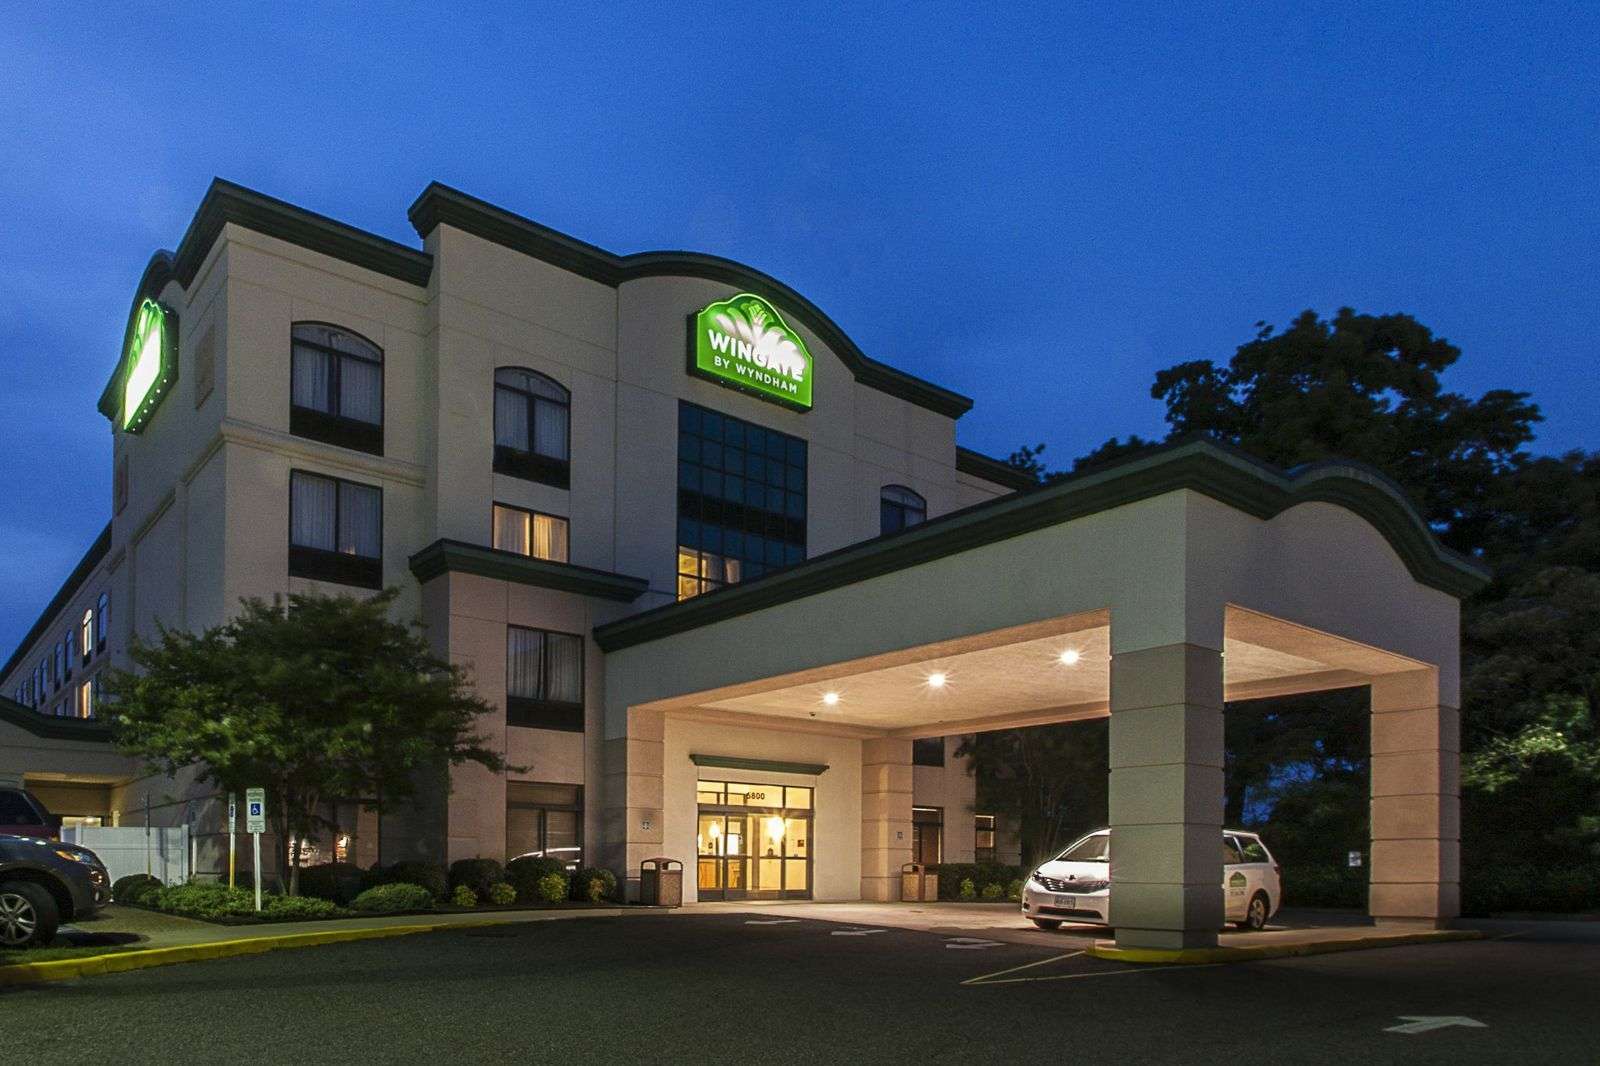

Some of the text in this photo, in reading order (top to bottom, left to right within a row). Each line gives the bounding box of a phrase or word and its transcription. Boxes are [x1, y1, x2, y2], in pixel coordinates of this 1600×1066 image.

[714, 355, 797, 394] BY WYNDHAM
[745, 791, 765, 800] 6800
